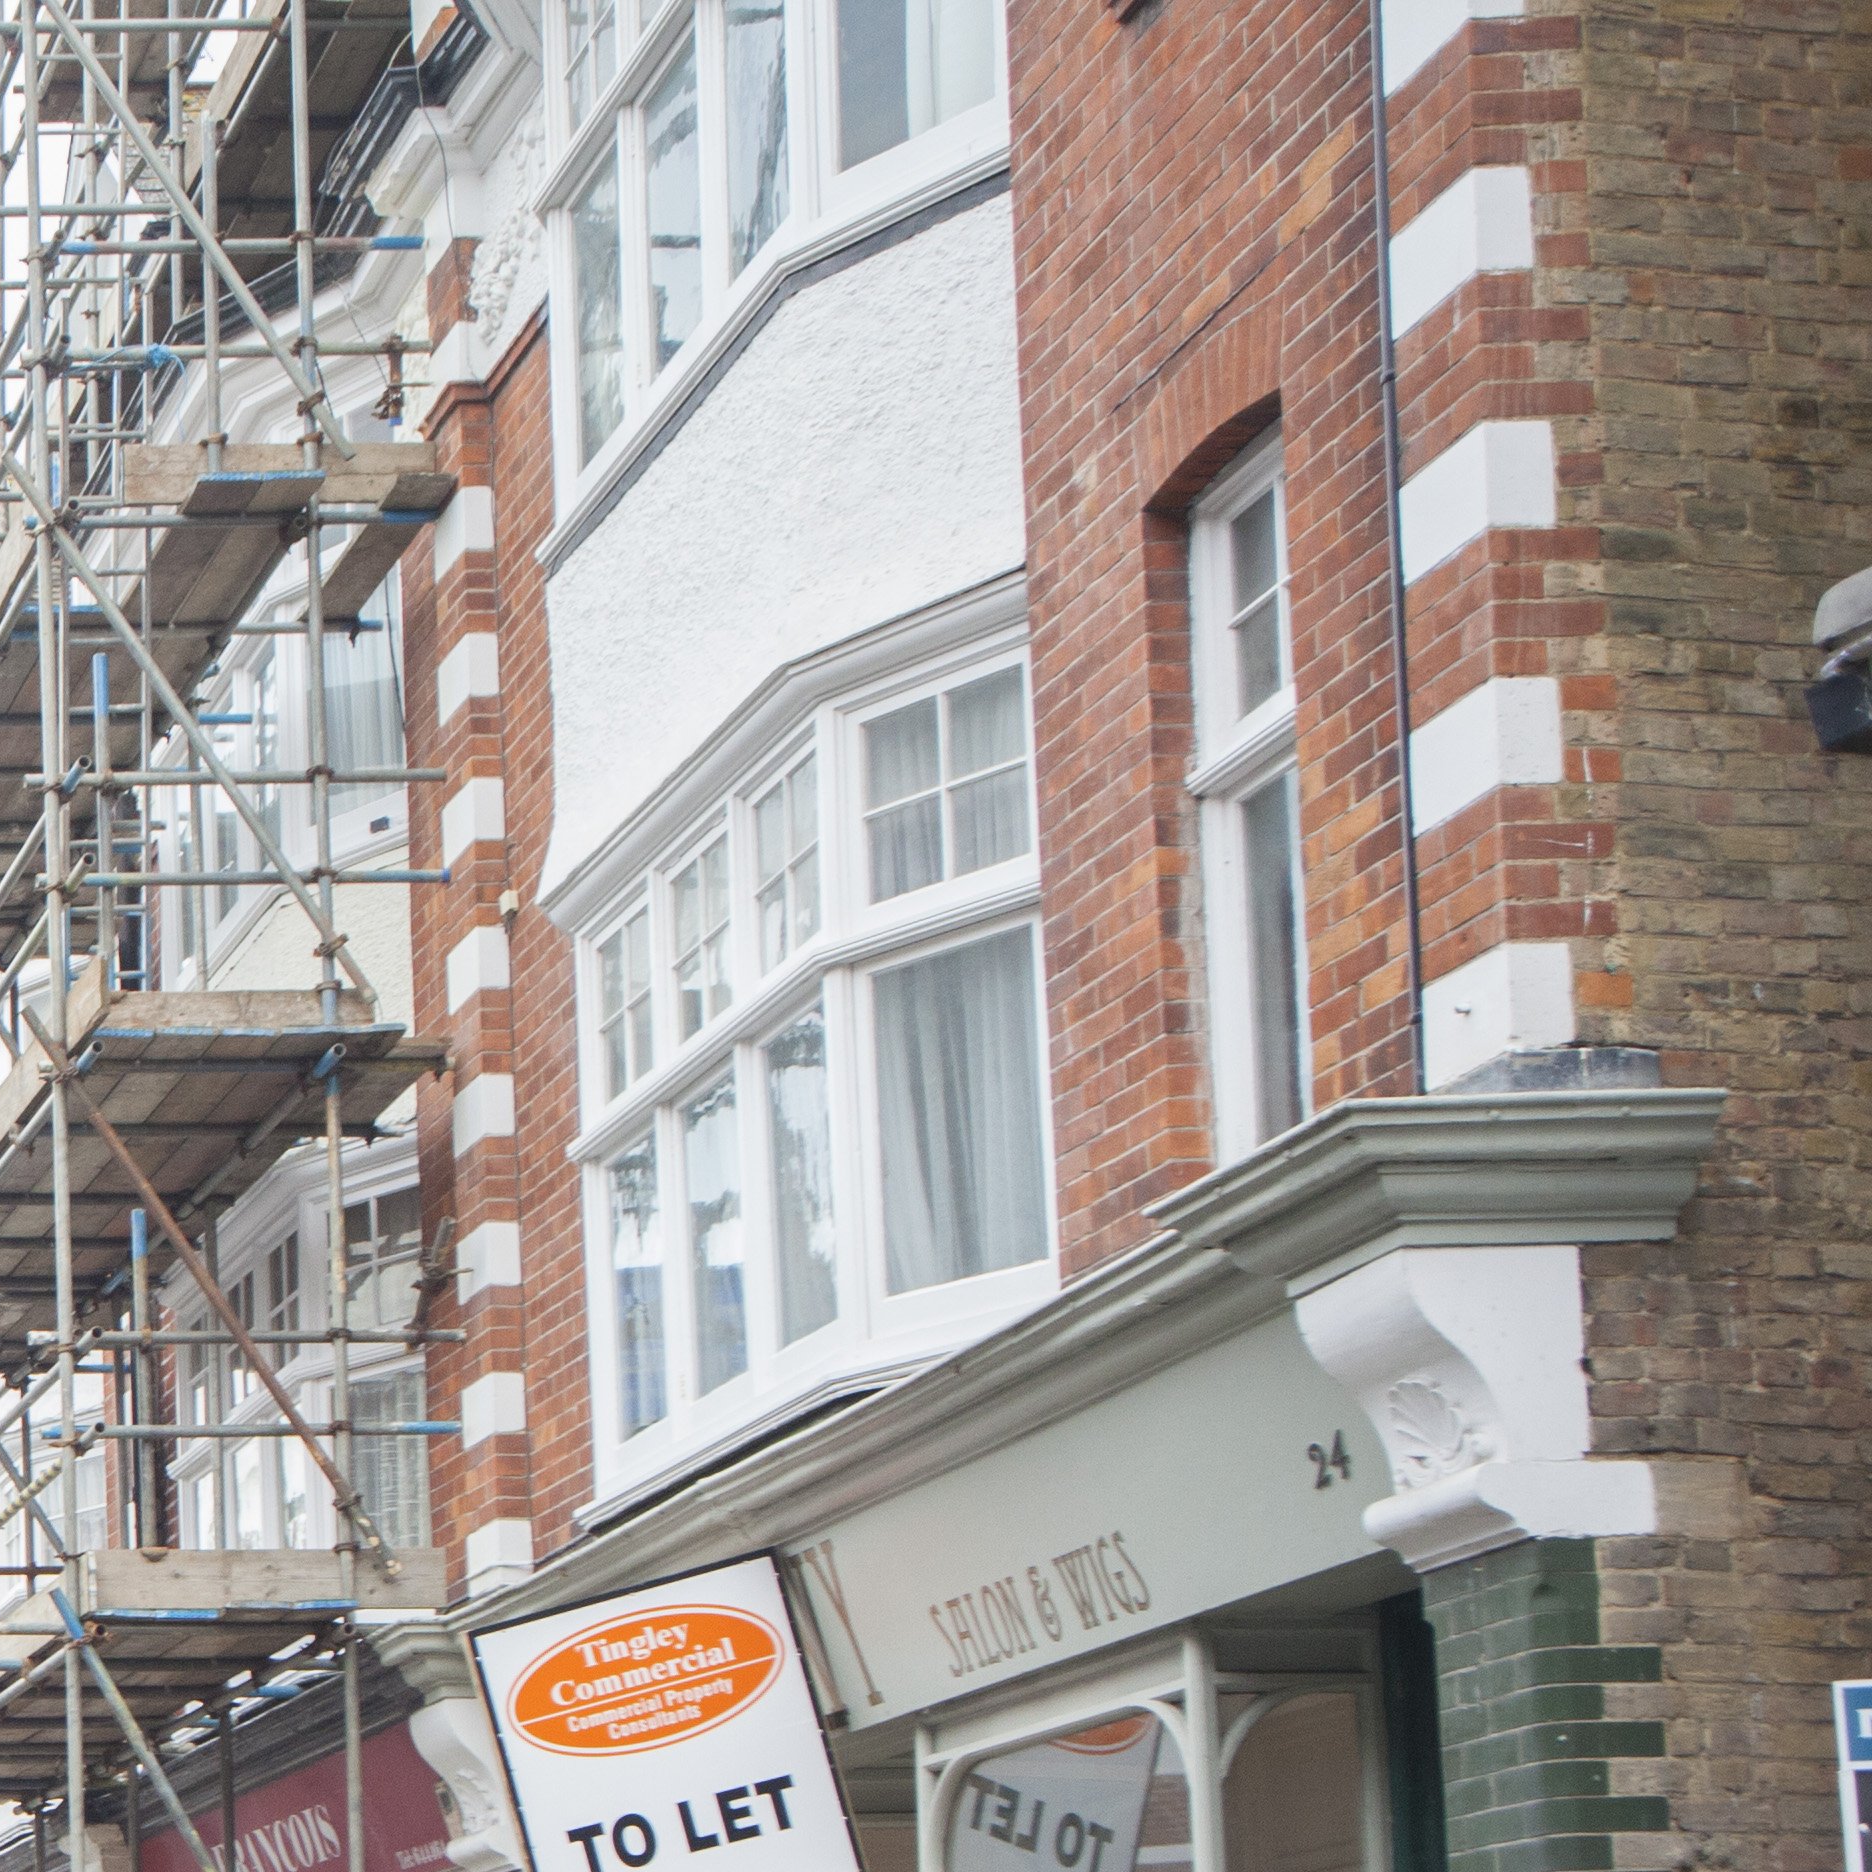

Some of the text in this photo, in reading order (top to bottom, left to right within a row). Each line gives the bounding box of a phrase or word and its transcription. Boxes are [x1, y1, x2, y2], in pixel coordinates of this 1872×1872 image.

[1307, 1429, 1351, 1489] 24
[1027, 1566, 1062, 1642] &
[1053, 1531, 1150, 1630] WIGS
[550, 1637, 737, 1706] Commercial
[574, 1623, 689, 1668] Tingley
[567, 1677, 734, 1733] Commercial Property
[609, 1705, 703, 1740] Consultants
[677, 1774, 794, 1853] LET
